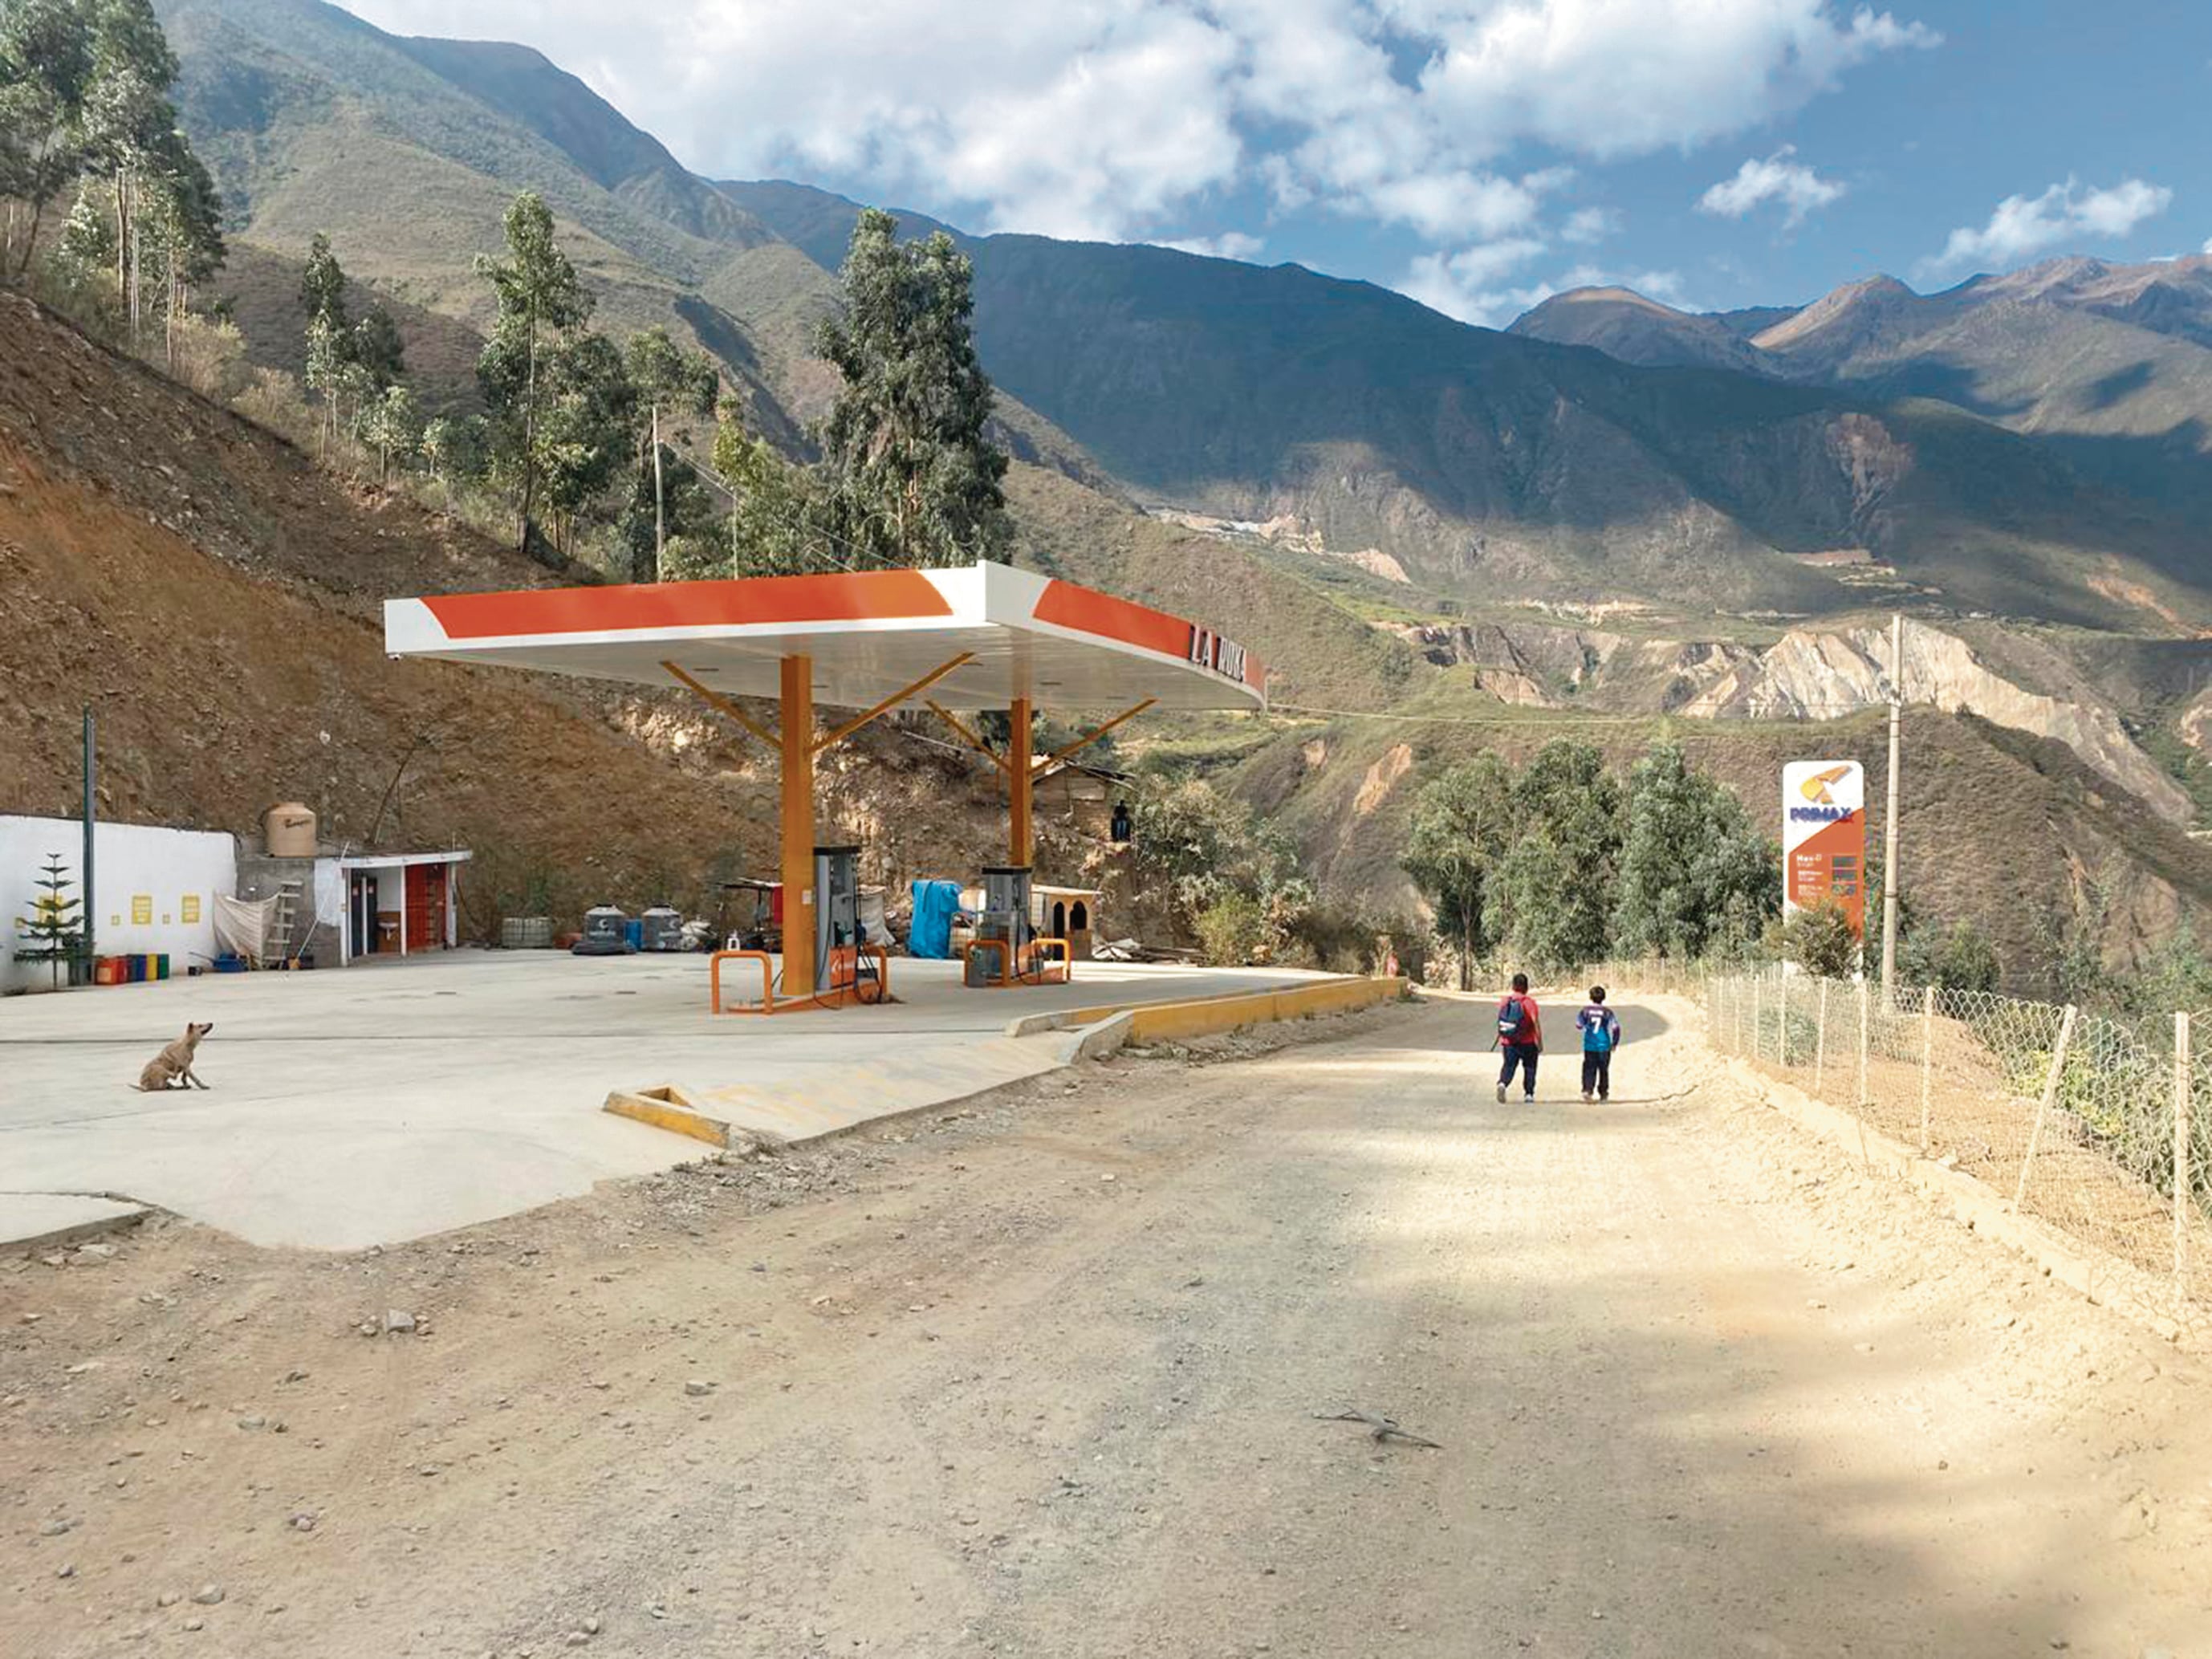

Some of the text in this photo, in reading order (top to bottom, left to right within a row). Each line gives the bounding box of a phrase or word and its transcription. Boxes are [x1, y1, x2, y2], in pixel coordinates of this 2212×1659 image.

[1191, 625, 1213, 668] LA
[1790, 806, 1853, 823] PRIMAX
[1591, 1016, 1601, 1034] 7
